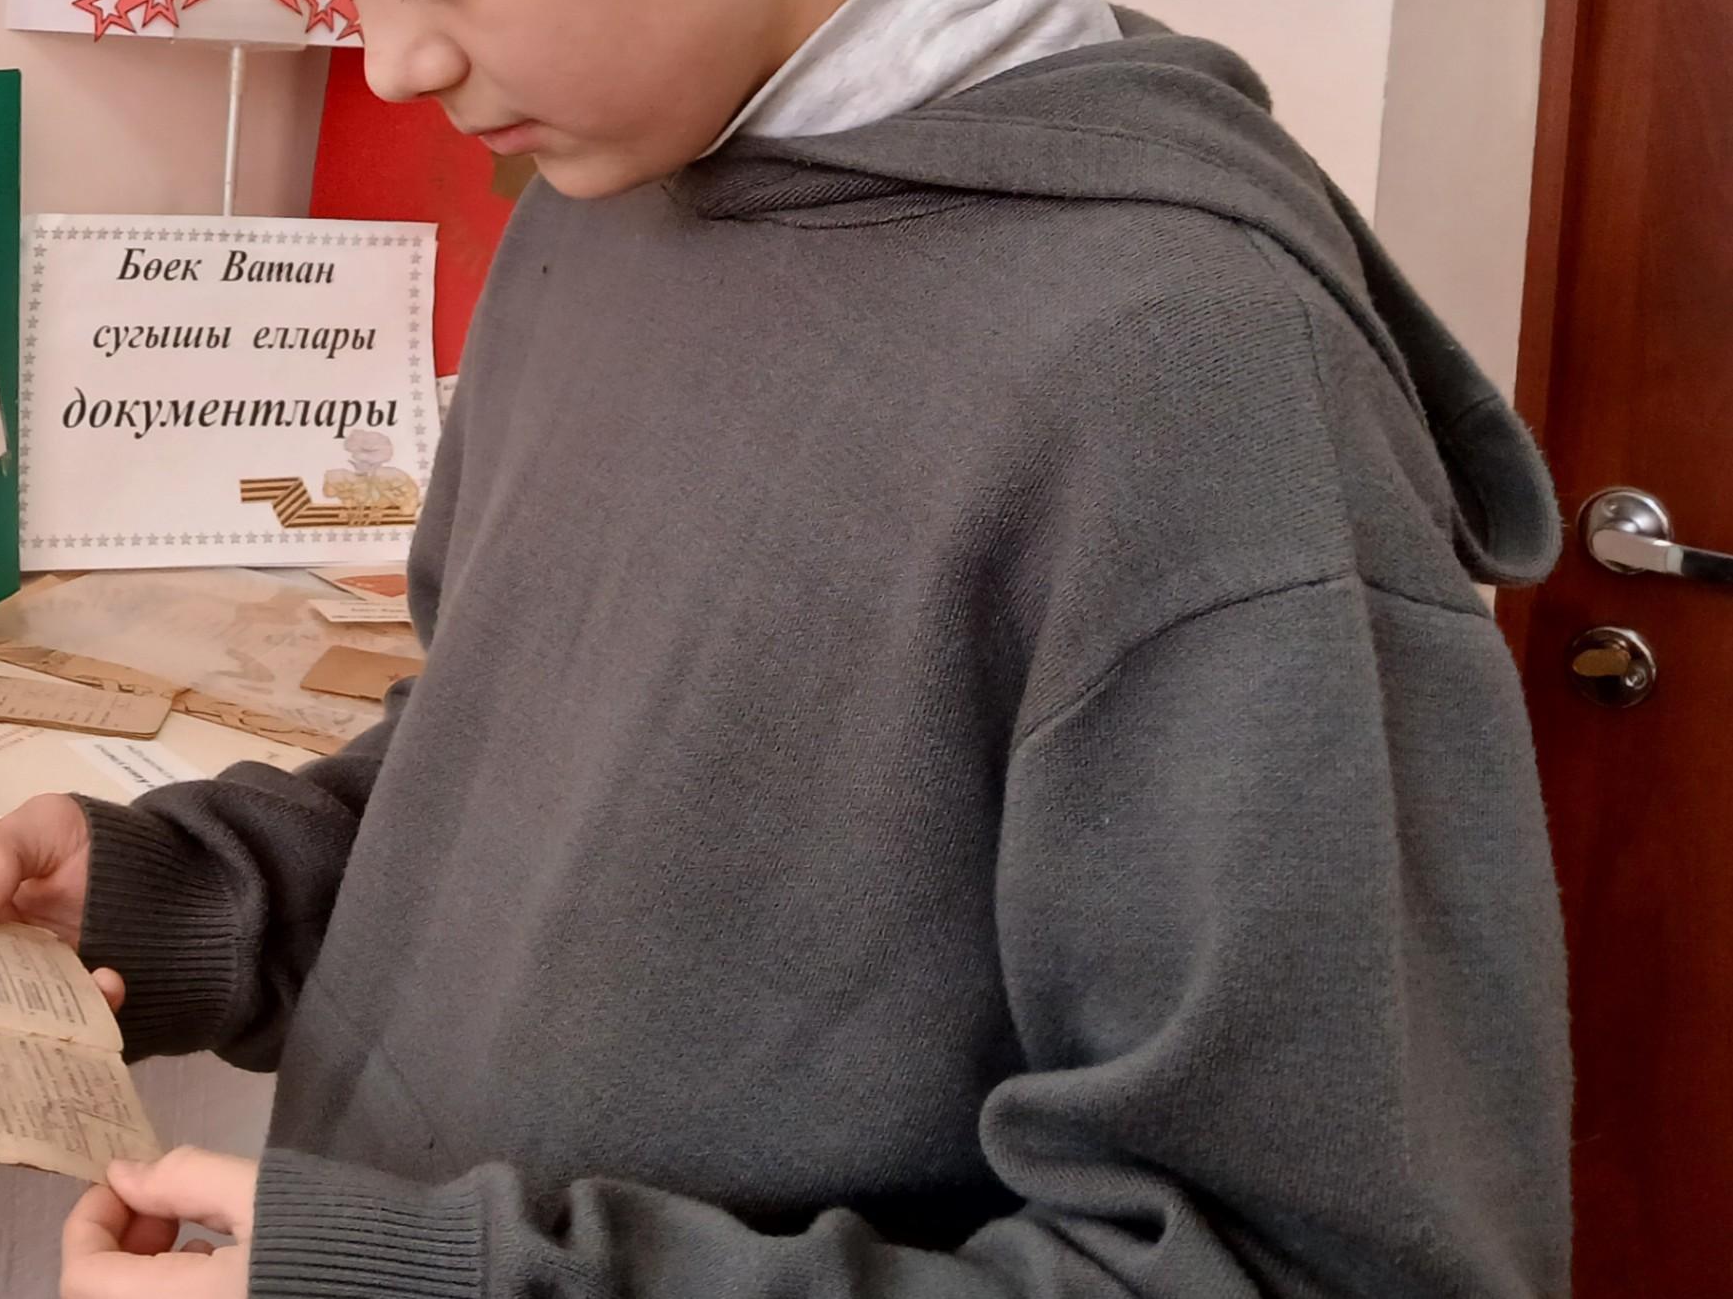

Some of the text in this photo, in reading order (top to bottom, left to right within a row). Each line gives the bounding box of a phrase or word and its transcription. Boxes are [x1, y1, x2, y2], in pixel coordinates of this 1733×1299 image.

[116, 247, 336, 285] Бөек Ватан
[92, 322, 377, 359] сугышы еллары
[62, 386, 399, 440] документлары
